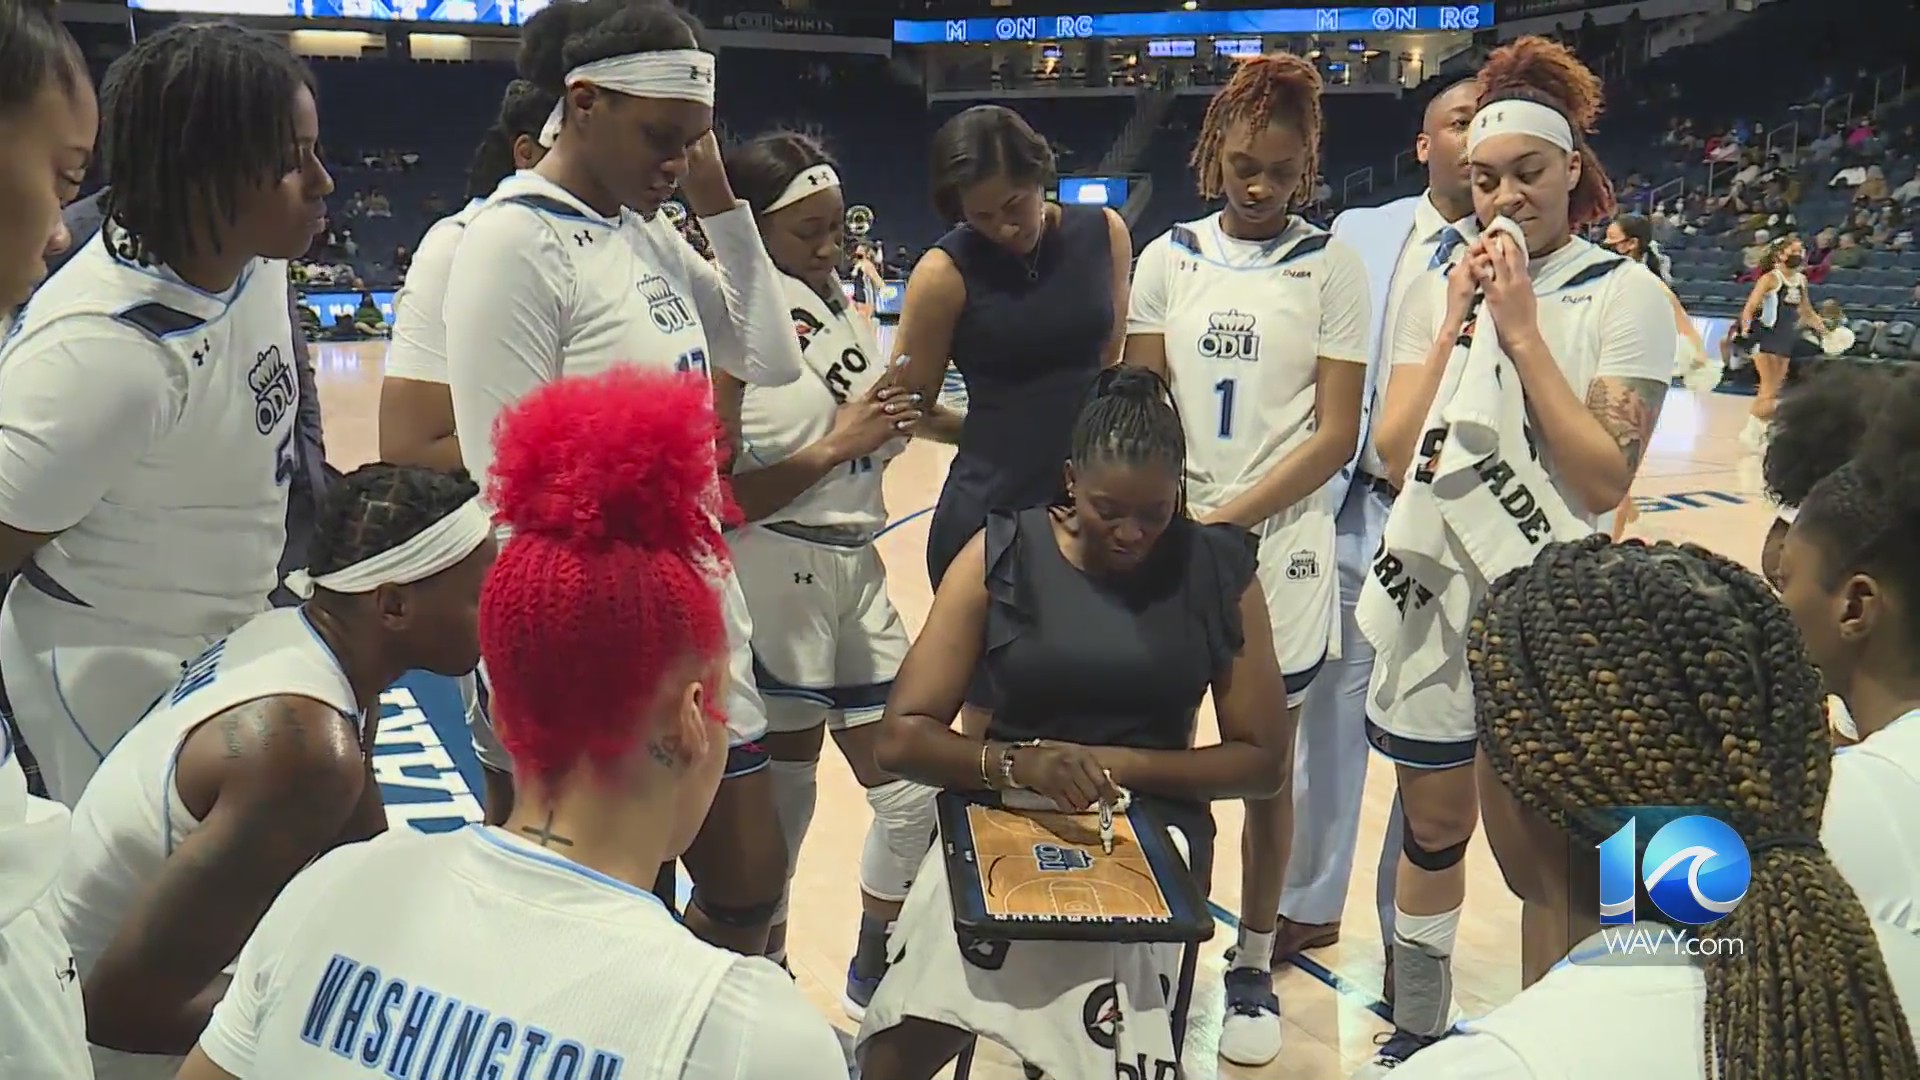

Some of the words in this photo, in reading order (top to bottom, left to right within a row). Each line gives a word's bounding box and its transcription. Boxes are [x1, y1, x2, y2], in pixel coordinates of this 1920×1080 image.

[649, 296, 697, 334] ODU
[1197, 332, 1260, 361] ODU
[255, 364, 297, 436] ODU
[1214, 377, 1237, 440] 1
[1473, 451, 1551, 545] ADE
[1285, 561, 1320, 580] ODU
